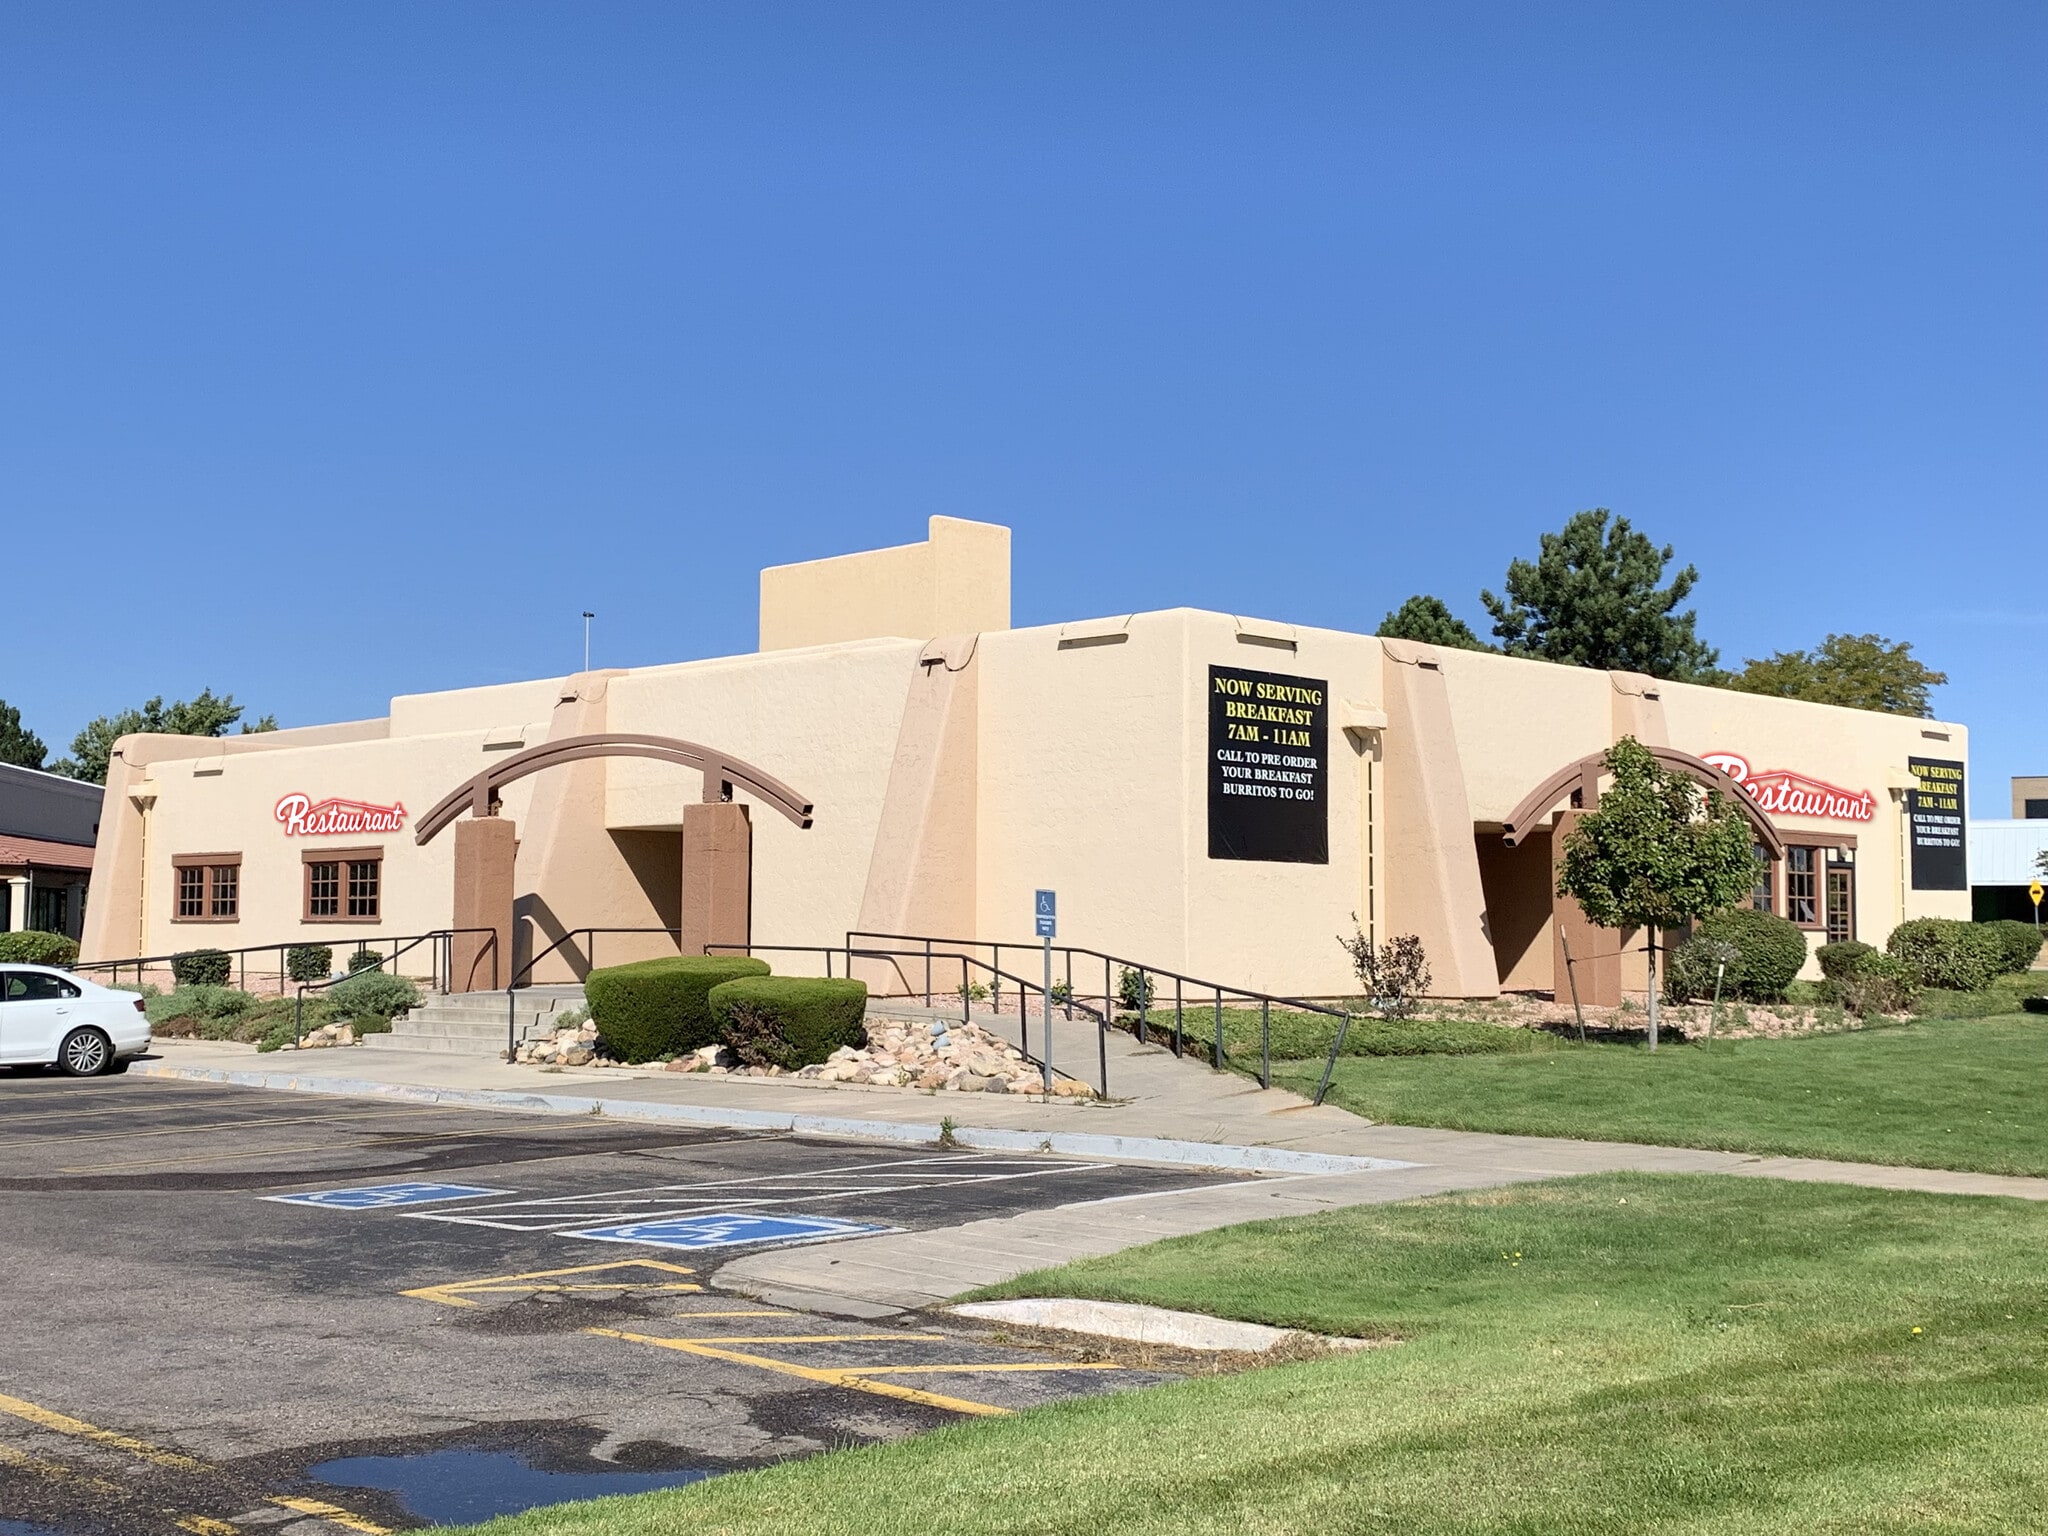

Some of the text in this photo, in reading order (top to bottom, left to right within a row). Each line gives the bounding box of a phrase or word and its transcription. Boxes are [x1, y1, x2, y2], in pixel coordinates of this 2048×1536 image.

[1214, 677, 1322, 706] NOW SERVING
[1225, 701, 1313, 726] BREAKFAST
[1227, 723, 1259, 742] 7AM
[1273, 728, 1310, 747] 11AM
[1217, 749, 1318, 769] CALL TO PRE ORDER
[1222, 765, 1313, 784] YOUR BREAKFAST
[1930, 766, 1962, 780] SERVING
[1223, 783, 1315, 801] BURRITOS TO GO!
[1918, 796, 1934, 809] 7AM
[1938, 797, 1958, 810] 11AM
[275, 793, 404, 836] Restaurant
